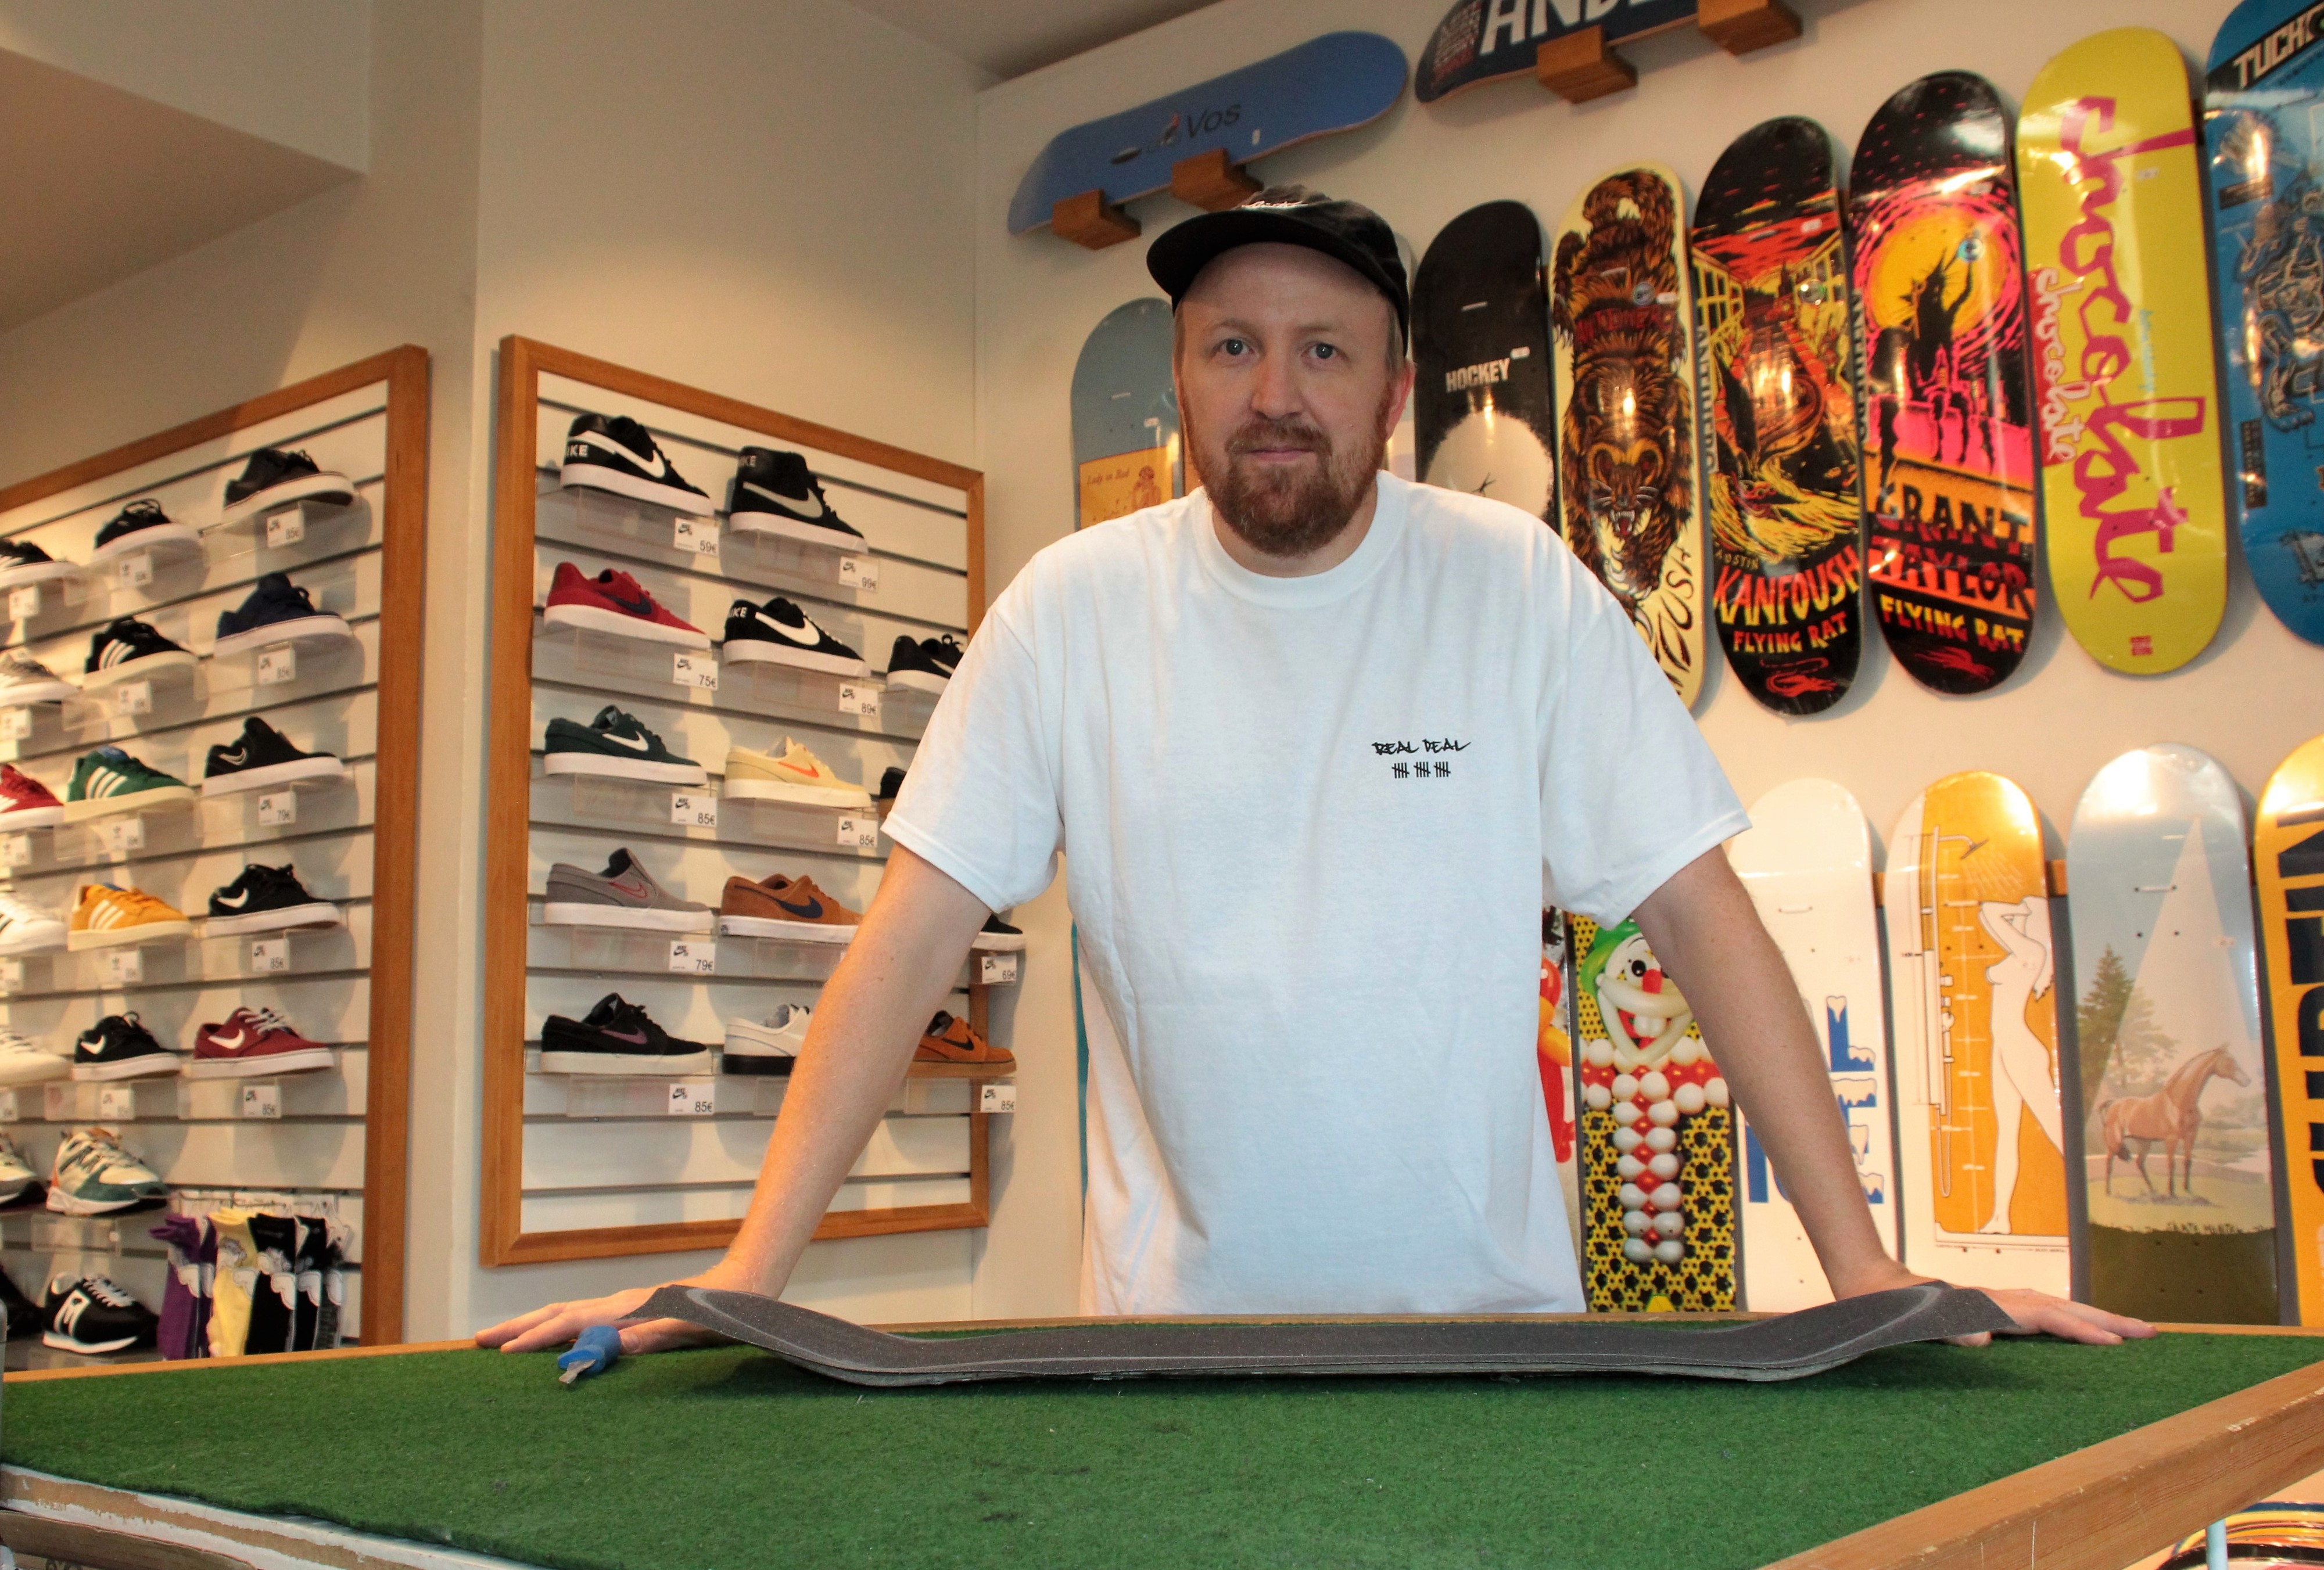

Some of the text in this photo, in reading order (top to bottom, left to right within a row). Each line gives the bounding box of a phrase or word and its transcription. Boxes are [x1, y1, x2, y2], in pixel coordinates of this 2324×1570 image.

[1446, 357, 1511, 393] HOCKEY
[566, 444, 588, 457] IKE
[1874, 481, 2031, 555] GRANT
[700, 540, 717, 554] 59€
[1869, 534, 2035, 616] TAYLOR
[1712, 544, 1860, 626] KANFOUSH
[1879, 594, 2025, 653] FLYING RAT
[1733, 610, 1848, 654] FLYING RAT
[699, 674, 716, 688] 75€
[861, 703, 877, 715] 89€
[1371, 738, 1472, 756] REAL DEAL
[697, 812, 716, 825] 85€
[859, 834, 875, 846] 85€
[695, 959, 713, 971] 79€
[1002, 970, 1016, 980] 69€
[694, 1101, 713, 1113] 85€
[1000, 1100, 1016, 1111] 85€
